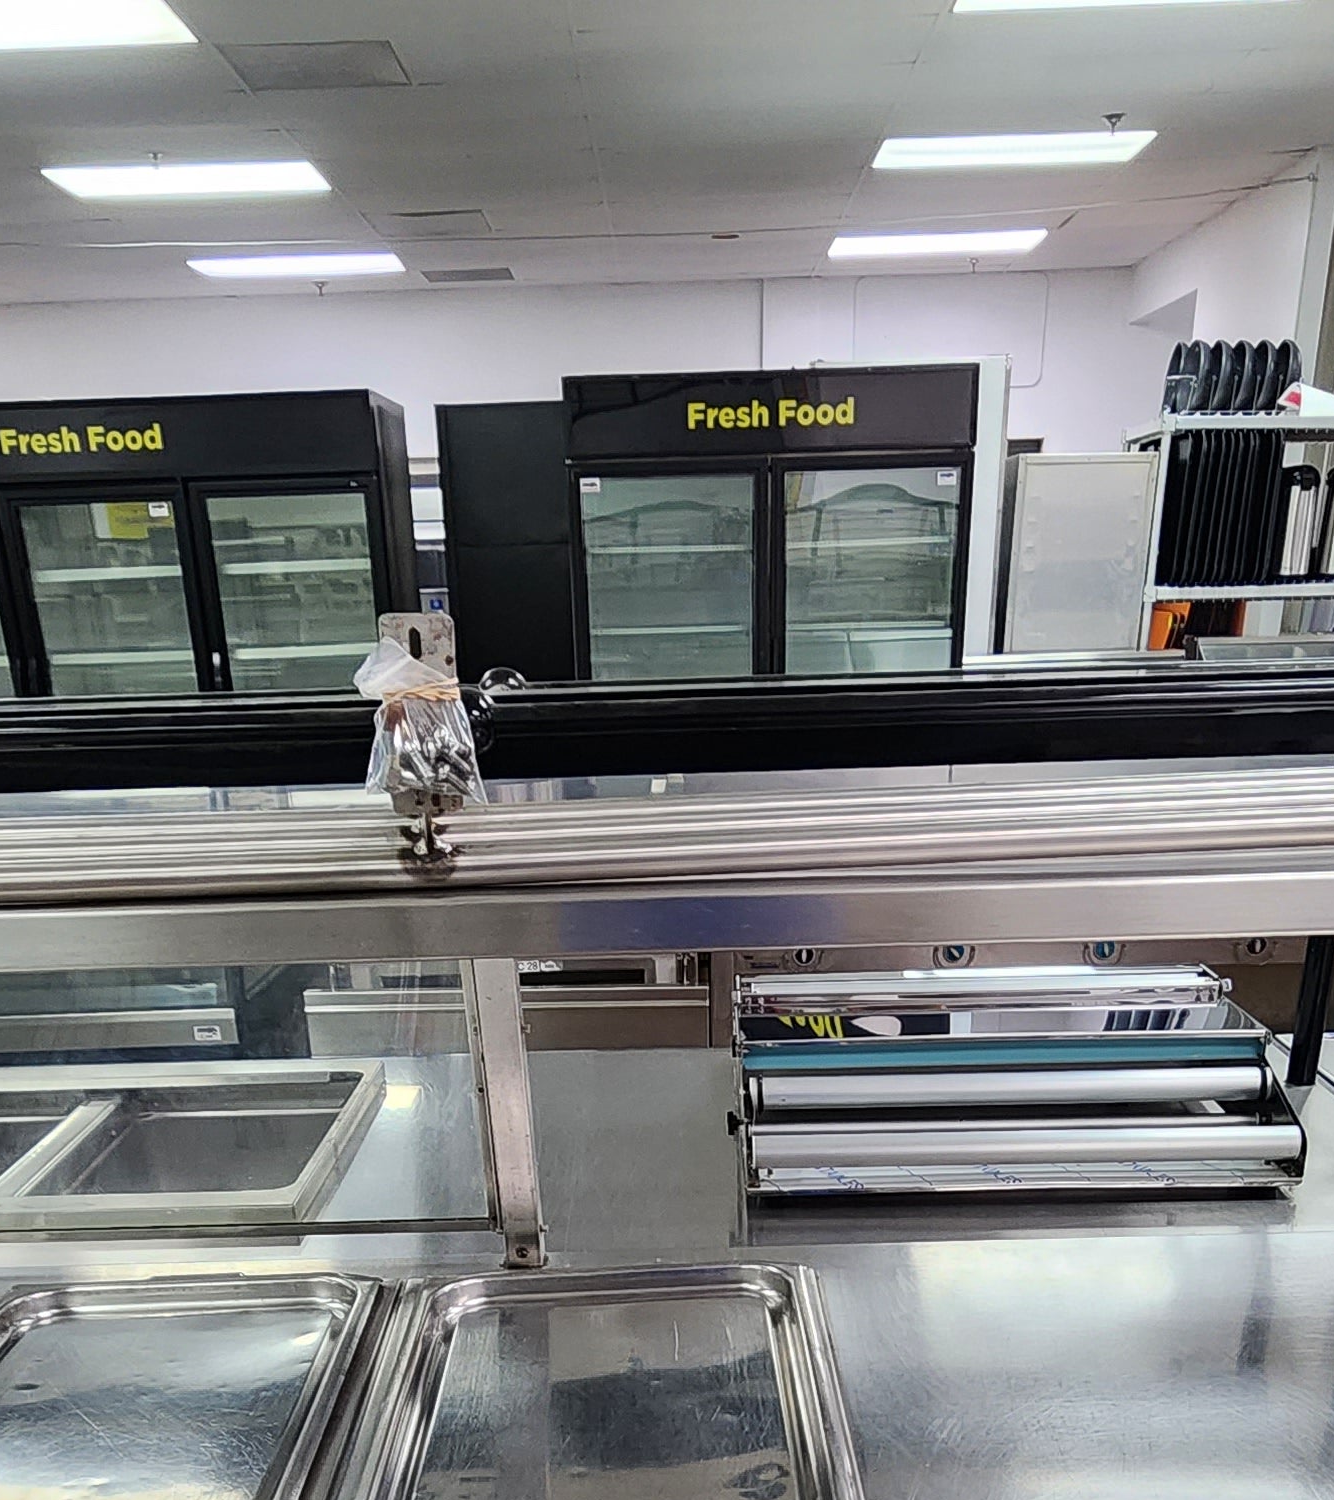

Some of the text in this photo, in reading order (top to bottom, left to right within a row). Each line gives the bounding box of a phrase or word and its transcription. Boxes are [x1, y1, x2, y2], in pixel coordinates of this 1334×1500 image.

[687, 396, 855, 430] Fresh Food
[86, 422, 165, 452] Food
